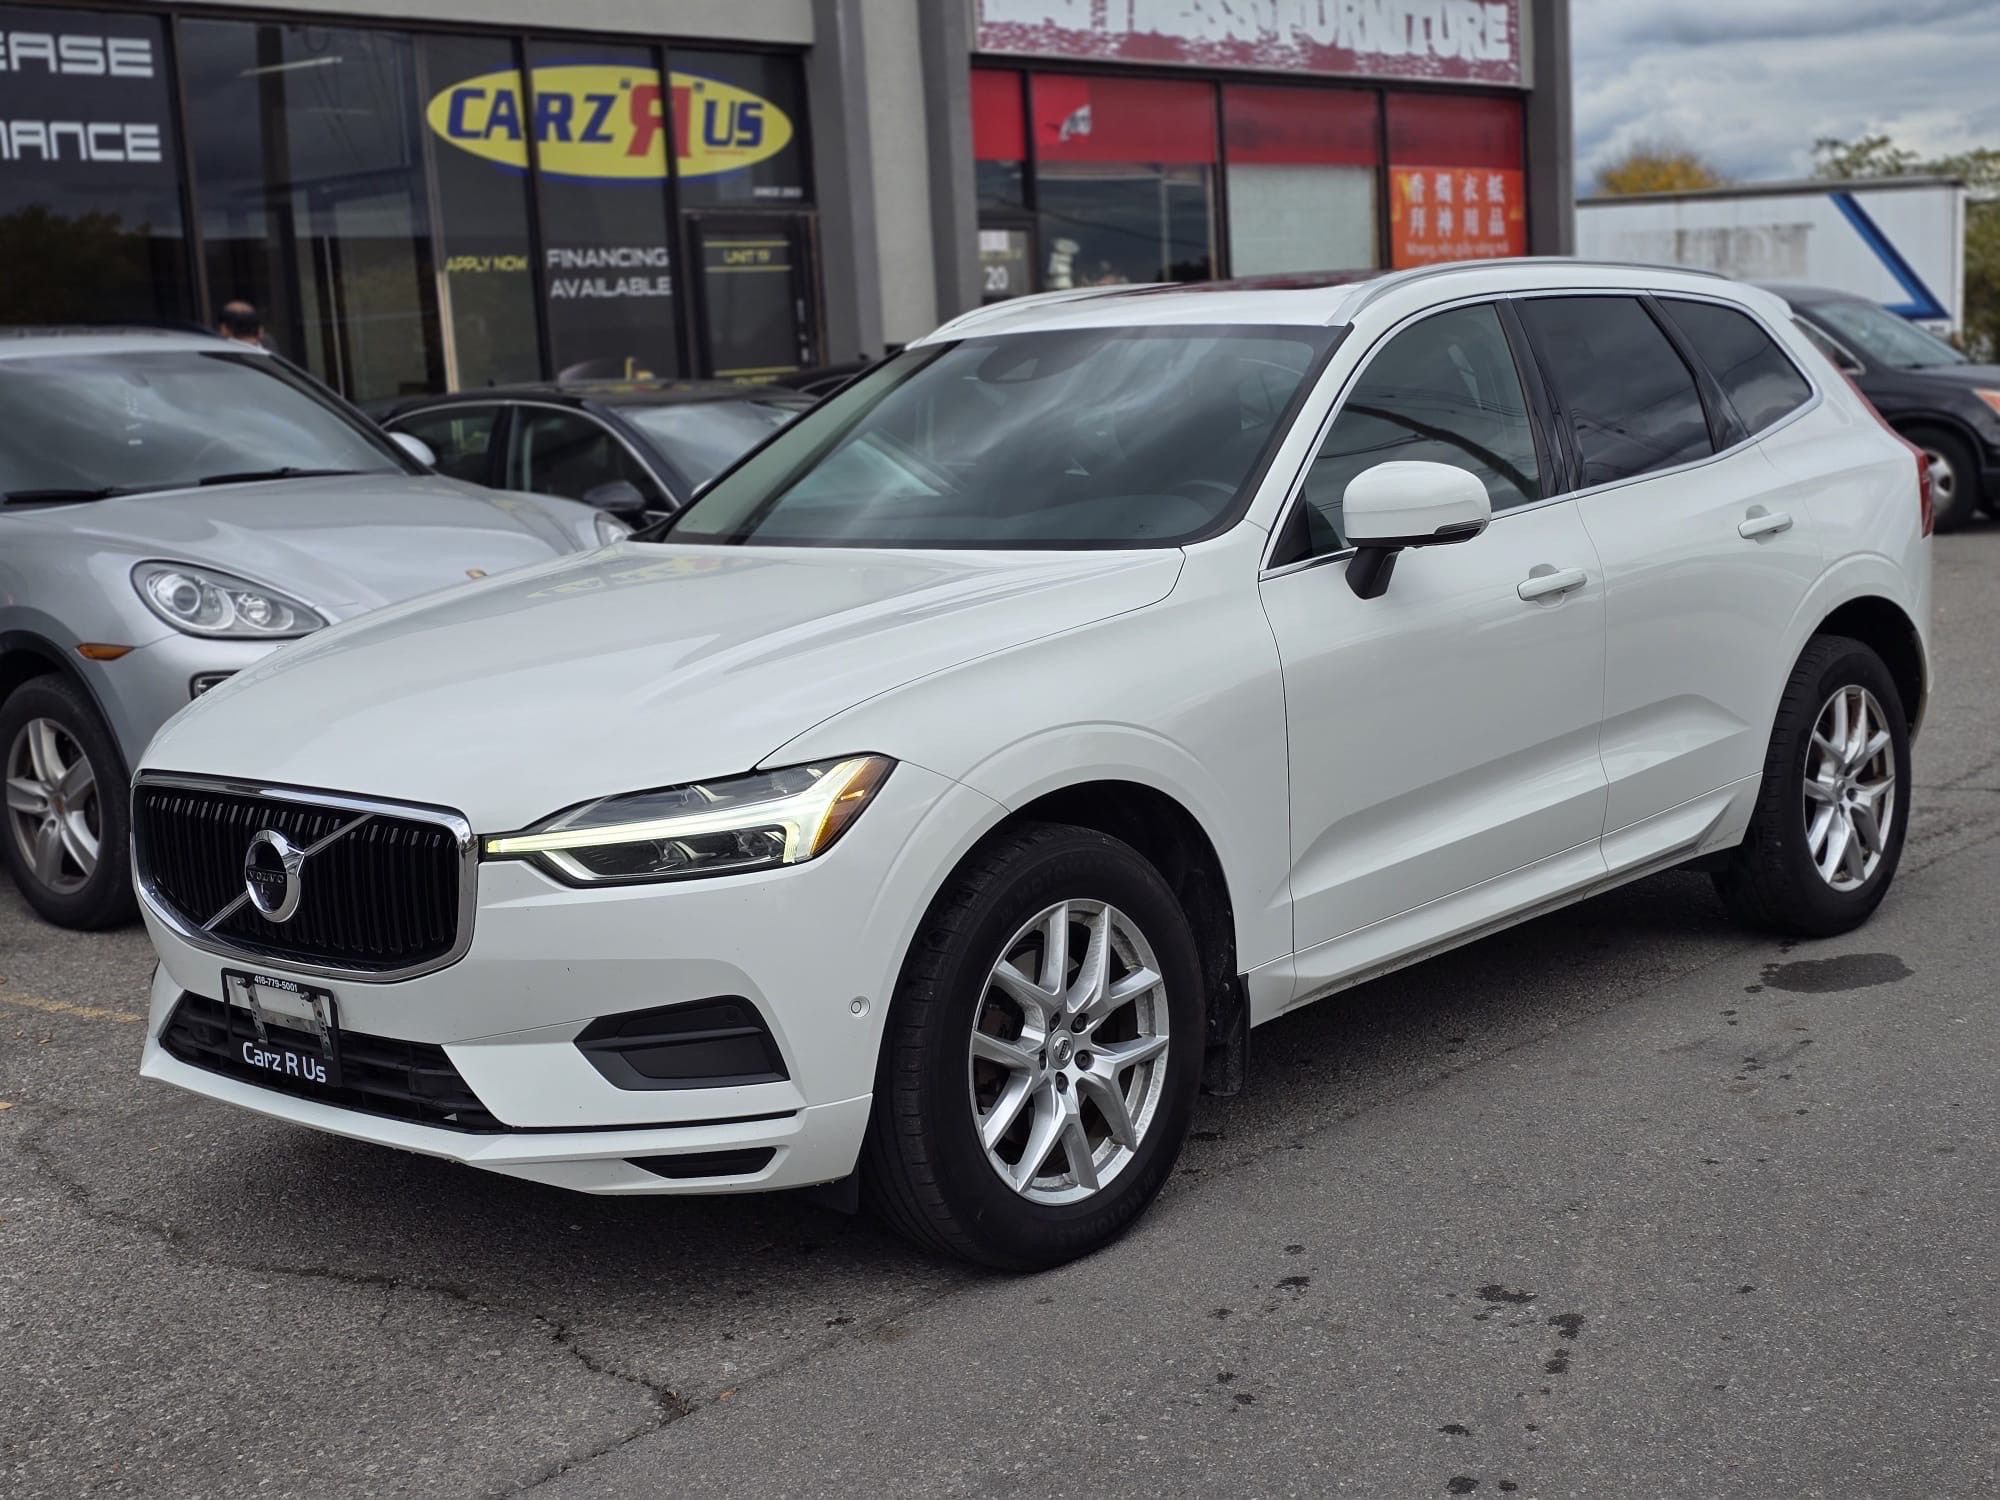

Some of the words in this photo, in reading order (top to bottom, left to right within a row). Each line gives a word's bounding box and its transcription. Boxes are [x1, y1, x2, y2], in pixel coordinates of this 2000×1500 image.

[0, 31, 154, 77] ASE
[447, 88, 618, 143] CARZ
[702, 100, 764, 147] US
[0, 120, 161, 161] ANCE
[446, 256, 490, 273] APPLY
[494, 256, 528, 272] NOW
[547, 247, 669, 269] FINANCING
[550, 276, 672, 298] AVAILABLE
[984, 265, 1009, 290] 20
[254, 974, 298, 993] 416-779-5001
[242, 1041, 282, 1072] Carz
[285, 1051, 299, 1077] R
[302, 1056, 327, 1083] Us
